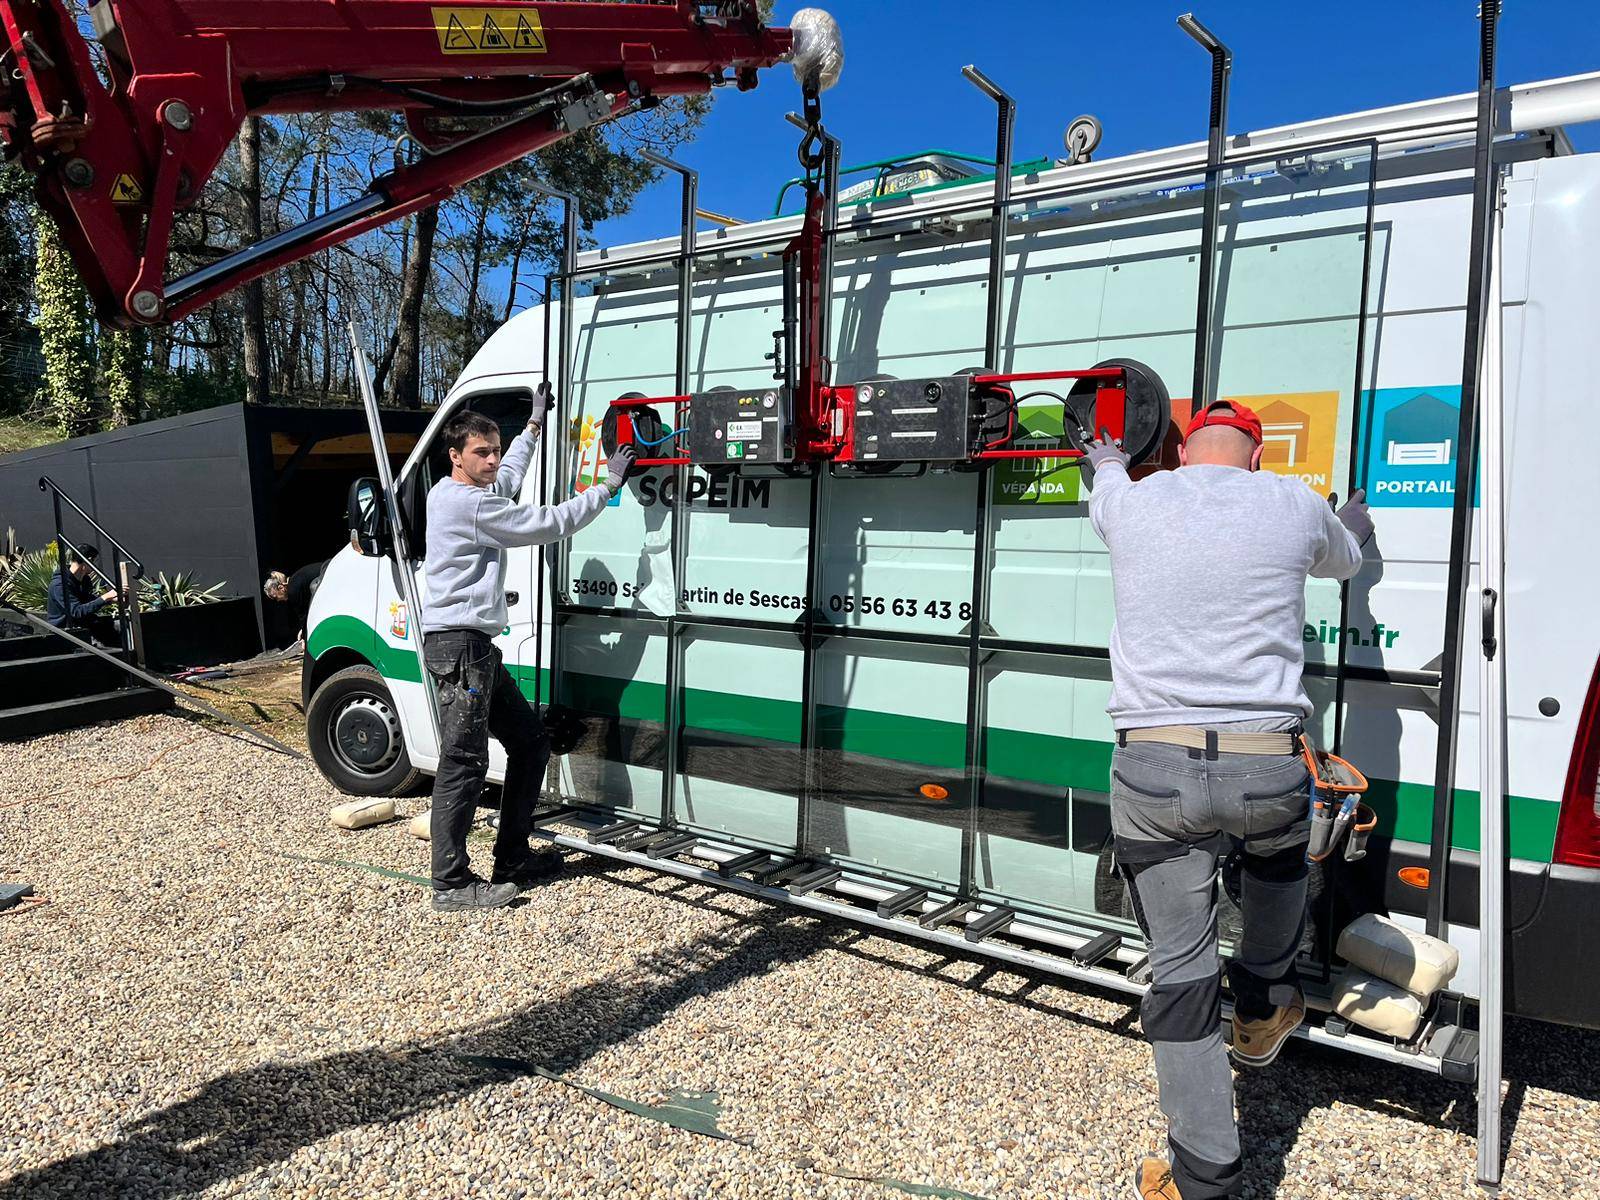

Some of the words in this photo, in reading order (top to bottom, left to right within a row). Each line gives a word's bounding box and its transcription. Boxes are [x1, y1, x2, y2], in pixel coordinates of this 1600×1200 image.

[1002, 481, 1065, 494] VÉRANDA
[1375, 480, 1455, 494] PORTAIL
[572, 579, 618, 596] 33490
[682, 587, 719, 604] artin
[724, 588, 744, 605] de
[829, 595, 854, 612] 05
[860, 596, 885, 615] 56
[892, 598, 917, 617] 63
[924, 600, 951, 619] 43
[958, 602, 972, 621] 8
[1303, 620, 1399, 648] eim.fr
